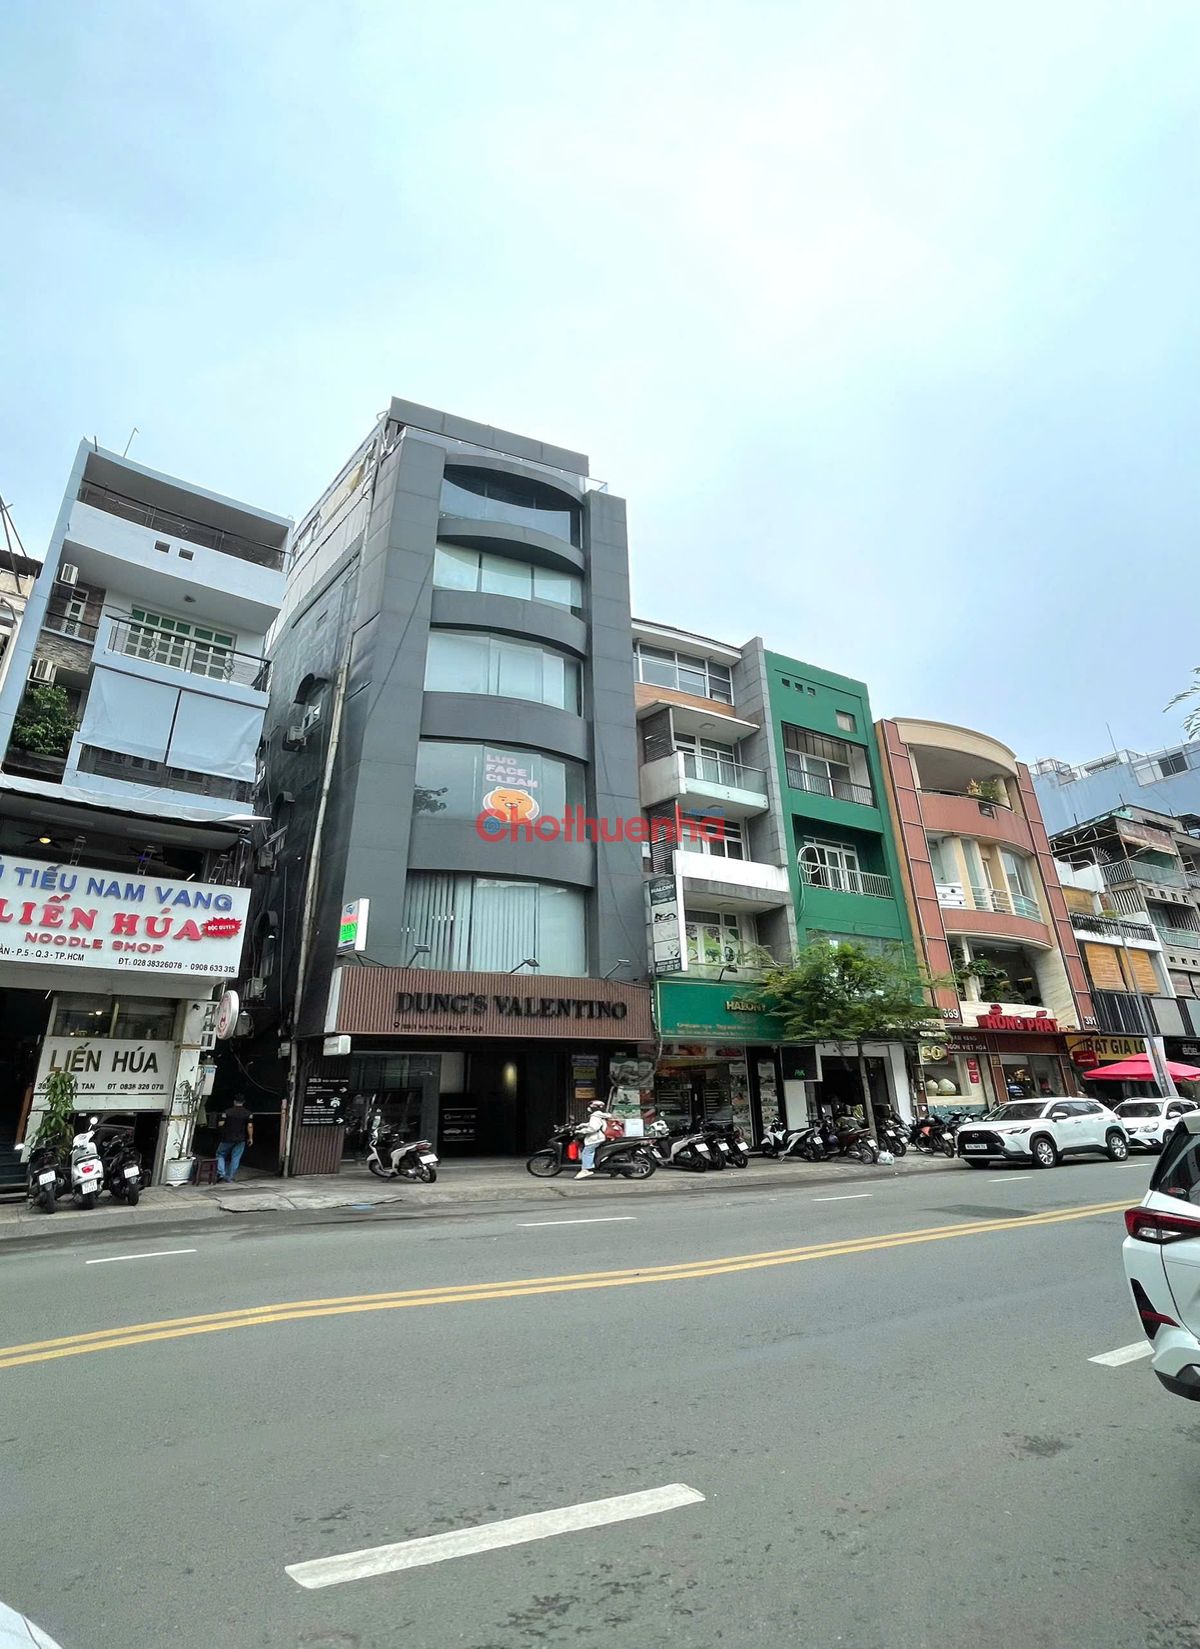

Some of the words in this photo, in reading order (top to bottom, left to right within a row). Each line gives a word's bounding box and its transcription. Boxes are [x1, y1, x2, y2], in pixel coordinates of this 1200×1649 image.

[486, 763, 528, 777] FACE
[486, 773, 539, 788] CLEAN
[14, 864, 78, 893] TIẾU
[86, 877, 146, 902] NAM
[155, 886, 233, 912] VANG
[0, 893, 99, 932] LIẾN
[110, 907, 203, 941] HÚA
[24, 932, 104, 950] NOODLE
[112, 940, 165, 954] SHOP
[209, 964, 223, 973] 633
[493, 994, 628, 1020] VALENTINO
[49, 1042, 102, 1073] LIẾN
[111, 1046, 159, 1074] HÚA
[1110, 1039, 1133, 1055] GIA
